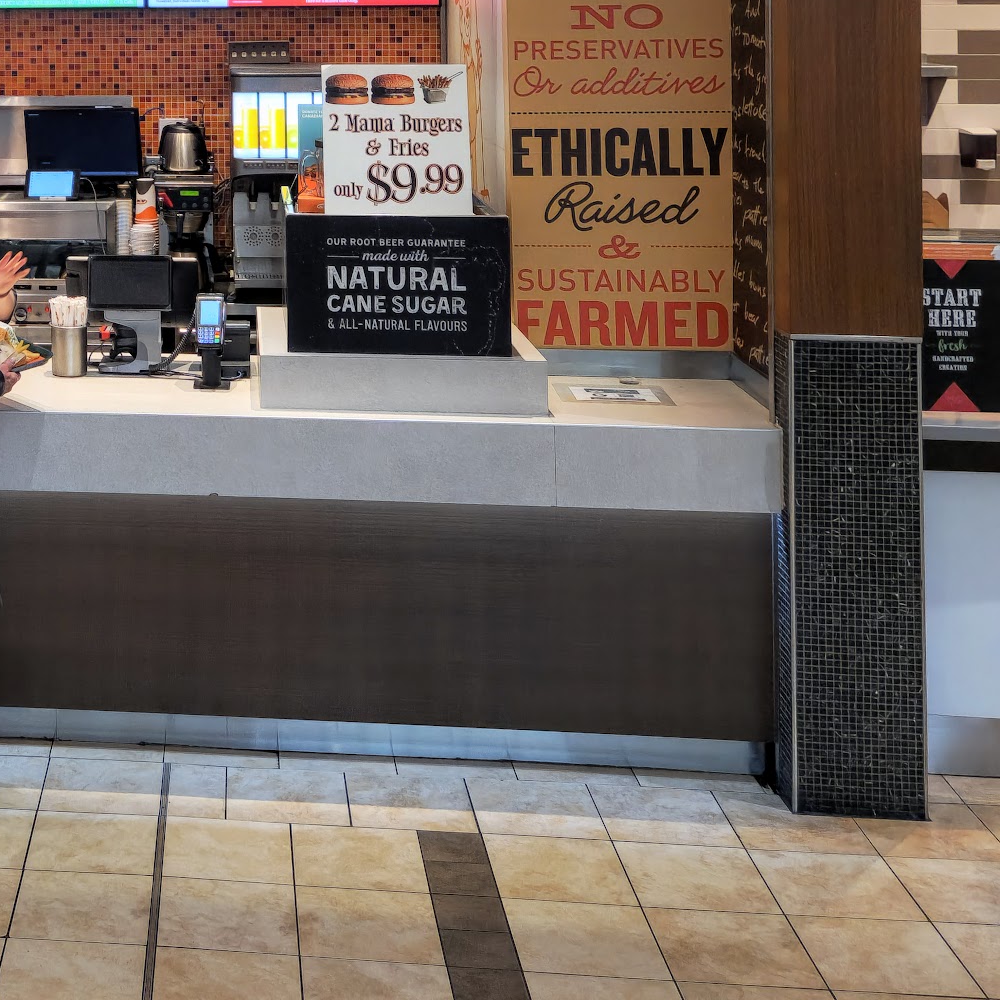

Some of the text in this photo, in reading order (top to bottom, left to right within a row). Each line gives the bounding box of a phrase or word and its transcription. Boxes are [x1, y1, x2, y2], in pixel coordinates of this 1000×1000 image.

[570, 4, 664, 30] NO
[513, 37, 725, 61] PRESERVATIVES
[513, 65, 725, 98] Or additives
[329, 113, 463, 136] 2 Mama Burgers
[365, 138, 430, 157] & Fries
[511, 127, 728, 177] ETHICALLY
[333, 160, 465, 206] only $9.99
[544, 180, 700, 232] Raised
[326, 238, 466, 248] OUR ROOT BEER GUARANTEE
[598, 234, 641, 260] &
[362, 250, 430, 262] made with
[327, 265, 467, 292] NATURAL
[517, 268, 726, 293] SUSTAINABLY
[326, 294, 468, 315] CANE SUGAR
[923, 288, 982, 306] START
[327, 318, 468, 332] & ALL-NATURAL FLAVOURS
[516, 300, 730, 348] FARMED
[928, 309, 977, 328] HERE
[937, 338, 968, 353] fresh
